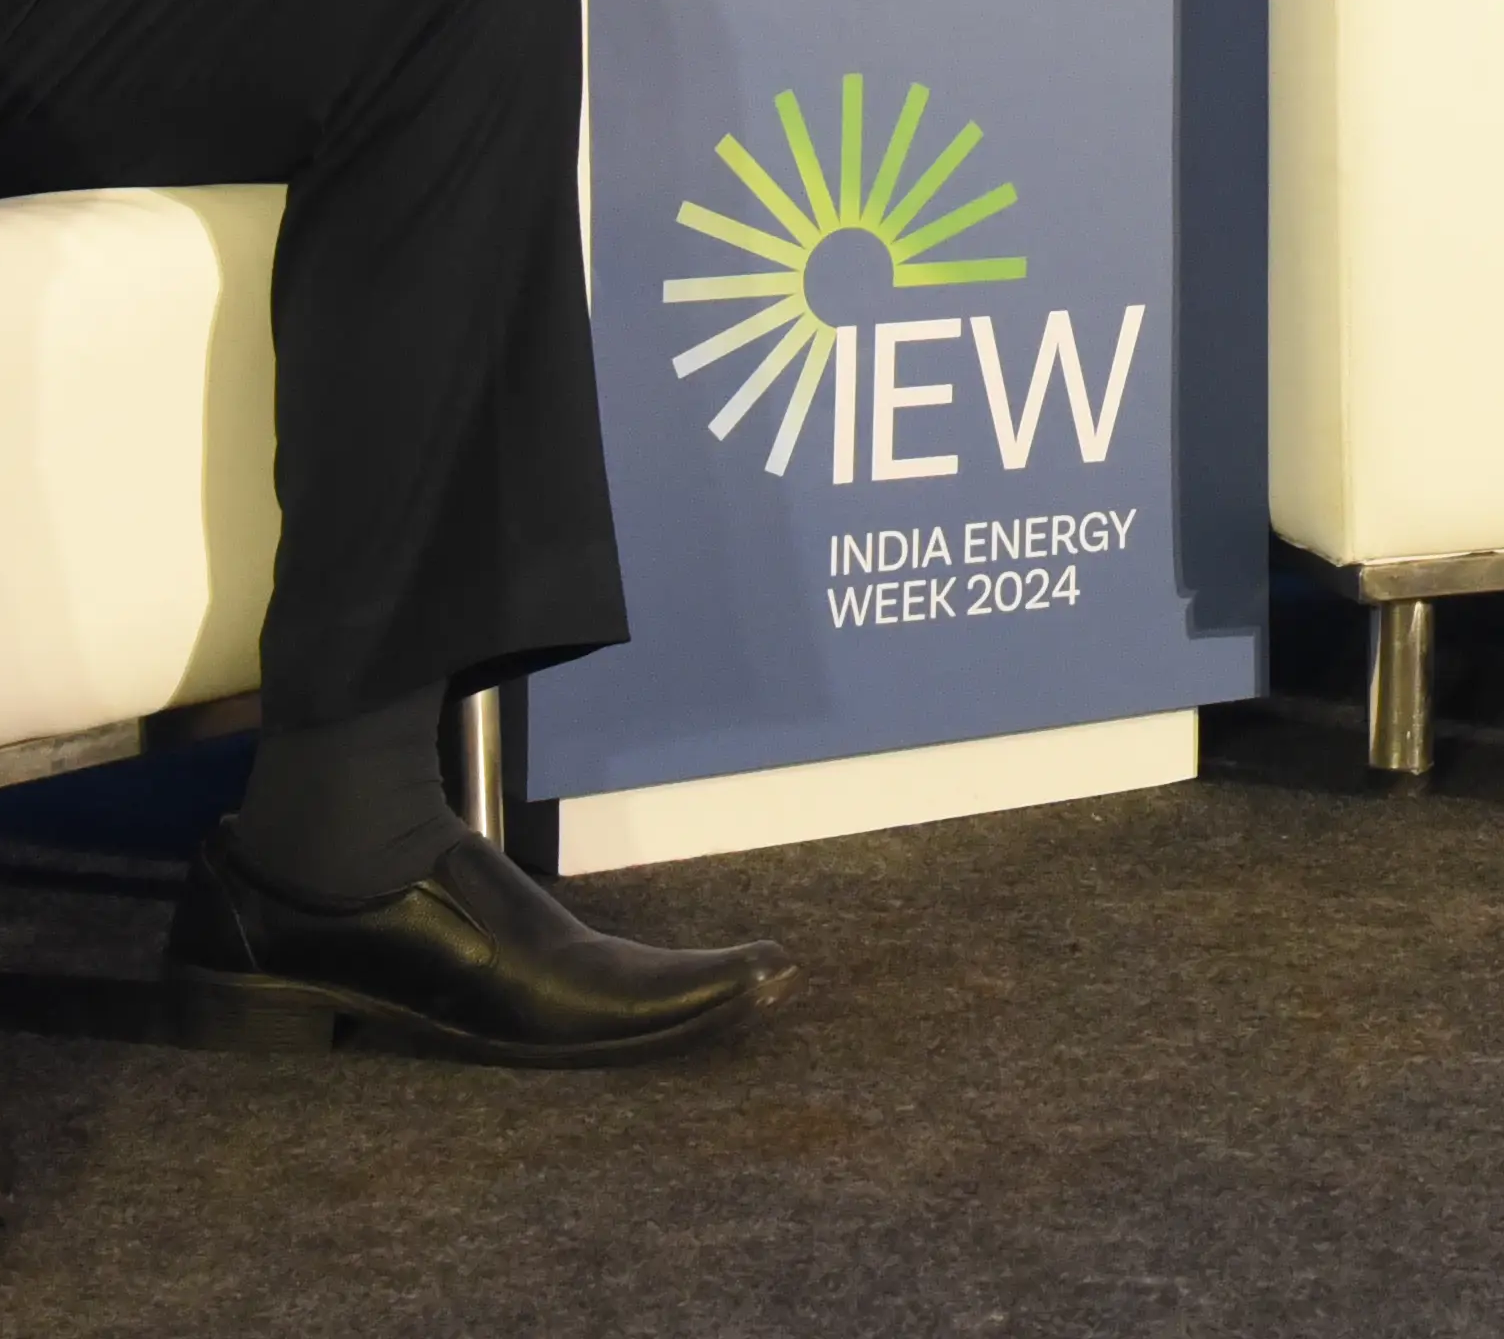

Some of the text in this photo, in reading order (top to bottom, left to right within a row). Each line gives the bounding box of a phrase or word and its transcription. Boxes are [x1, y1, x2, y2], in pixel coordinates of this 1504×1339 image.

[832, 304, 1146, 485] IEW
[830, 509, 1137, 577] INDIA ENERGY
[827, 565, 1081, 628] WEEK 2024
